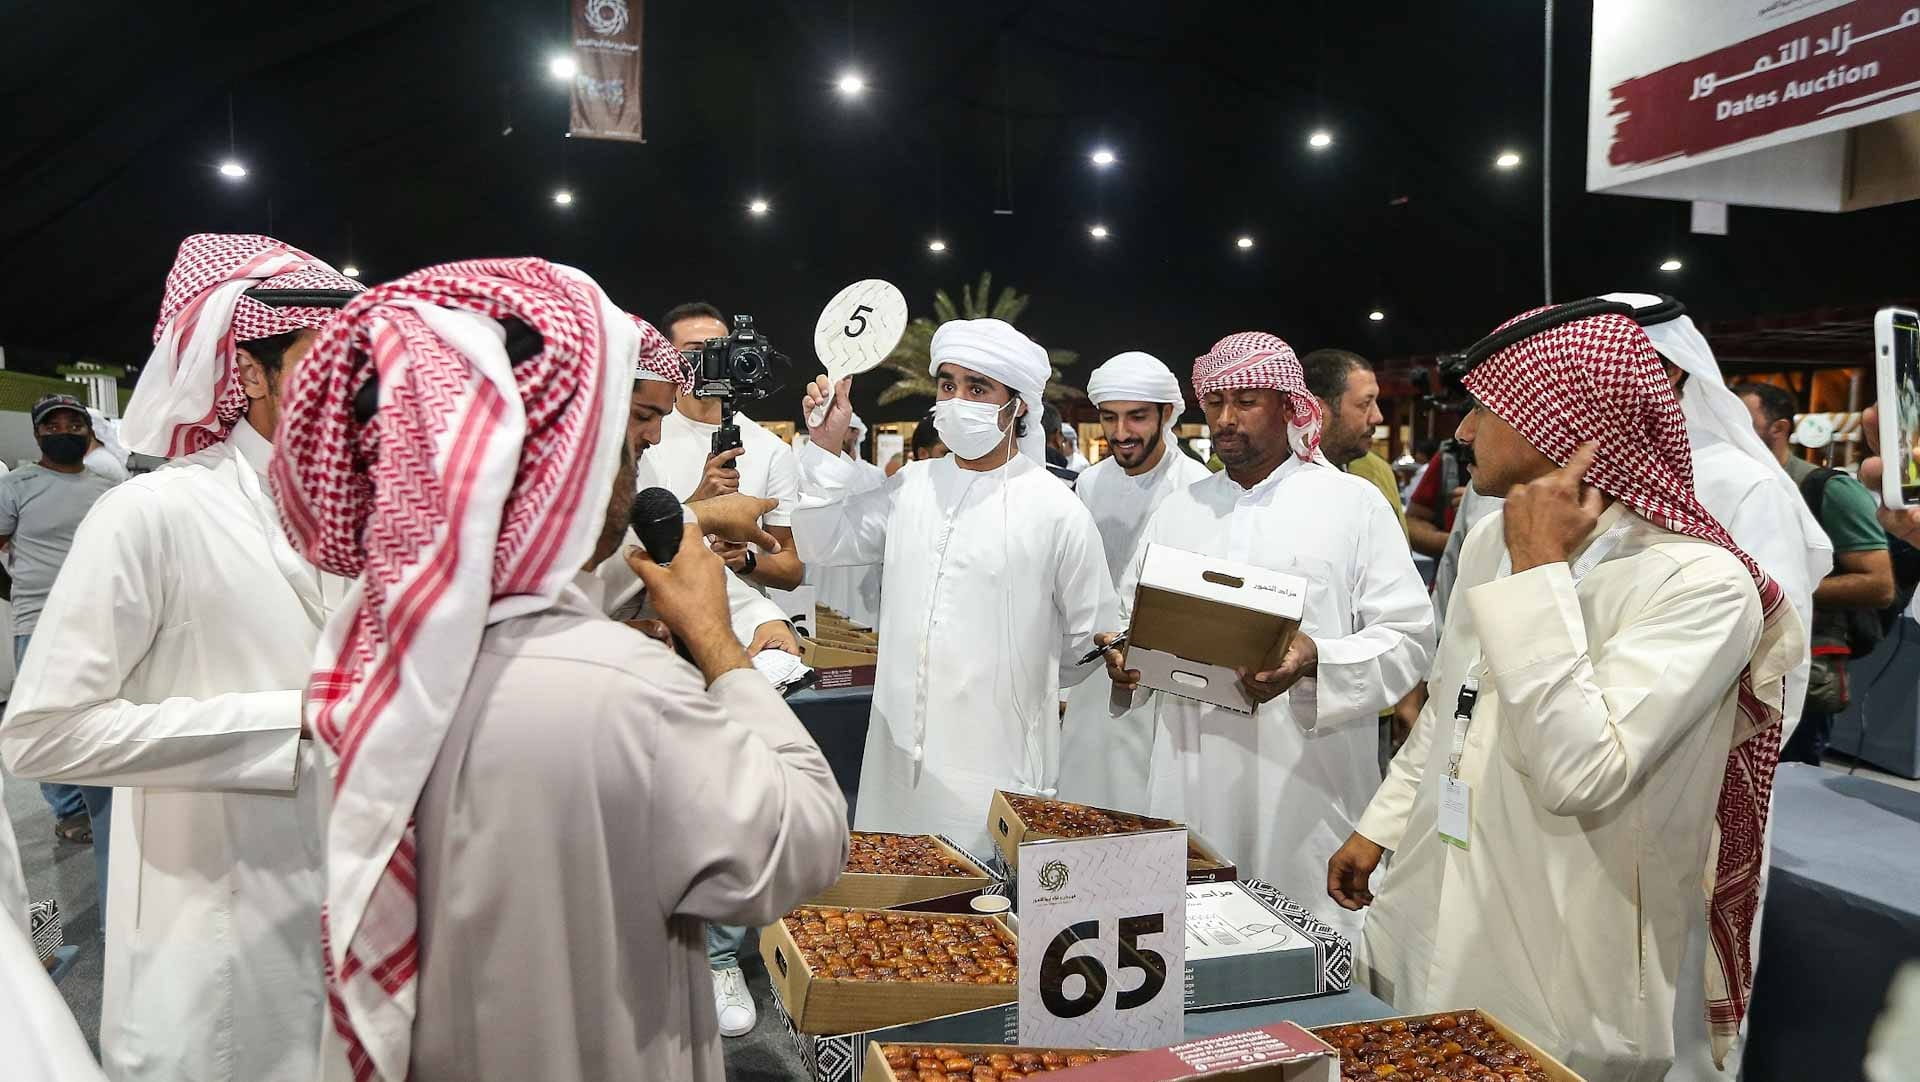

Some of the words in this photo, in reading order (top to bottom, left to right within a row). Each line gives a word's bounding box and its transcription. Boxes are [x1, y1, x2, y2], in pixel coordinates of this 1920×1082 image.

[1689, 36, 1809, 101] التمور
[1715, 90, 1778, 121] Dates
[1781, 60, 1880, 103] Auction
[844, 304, 874, 338] 5
[1039, 912, 1167, 1018] 65
